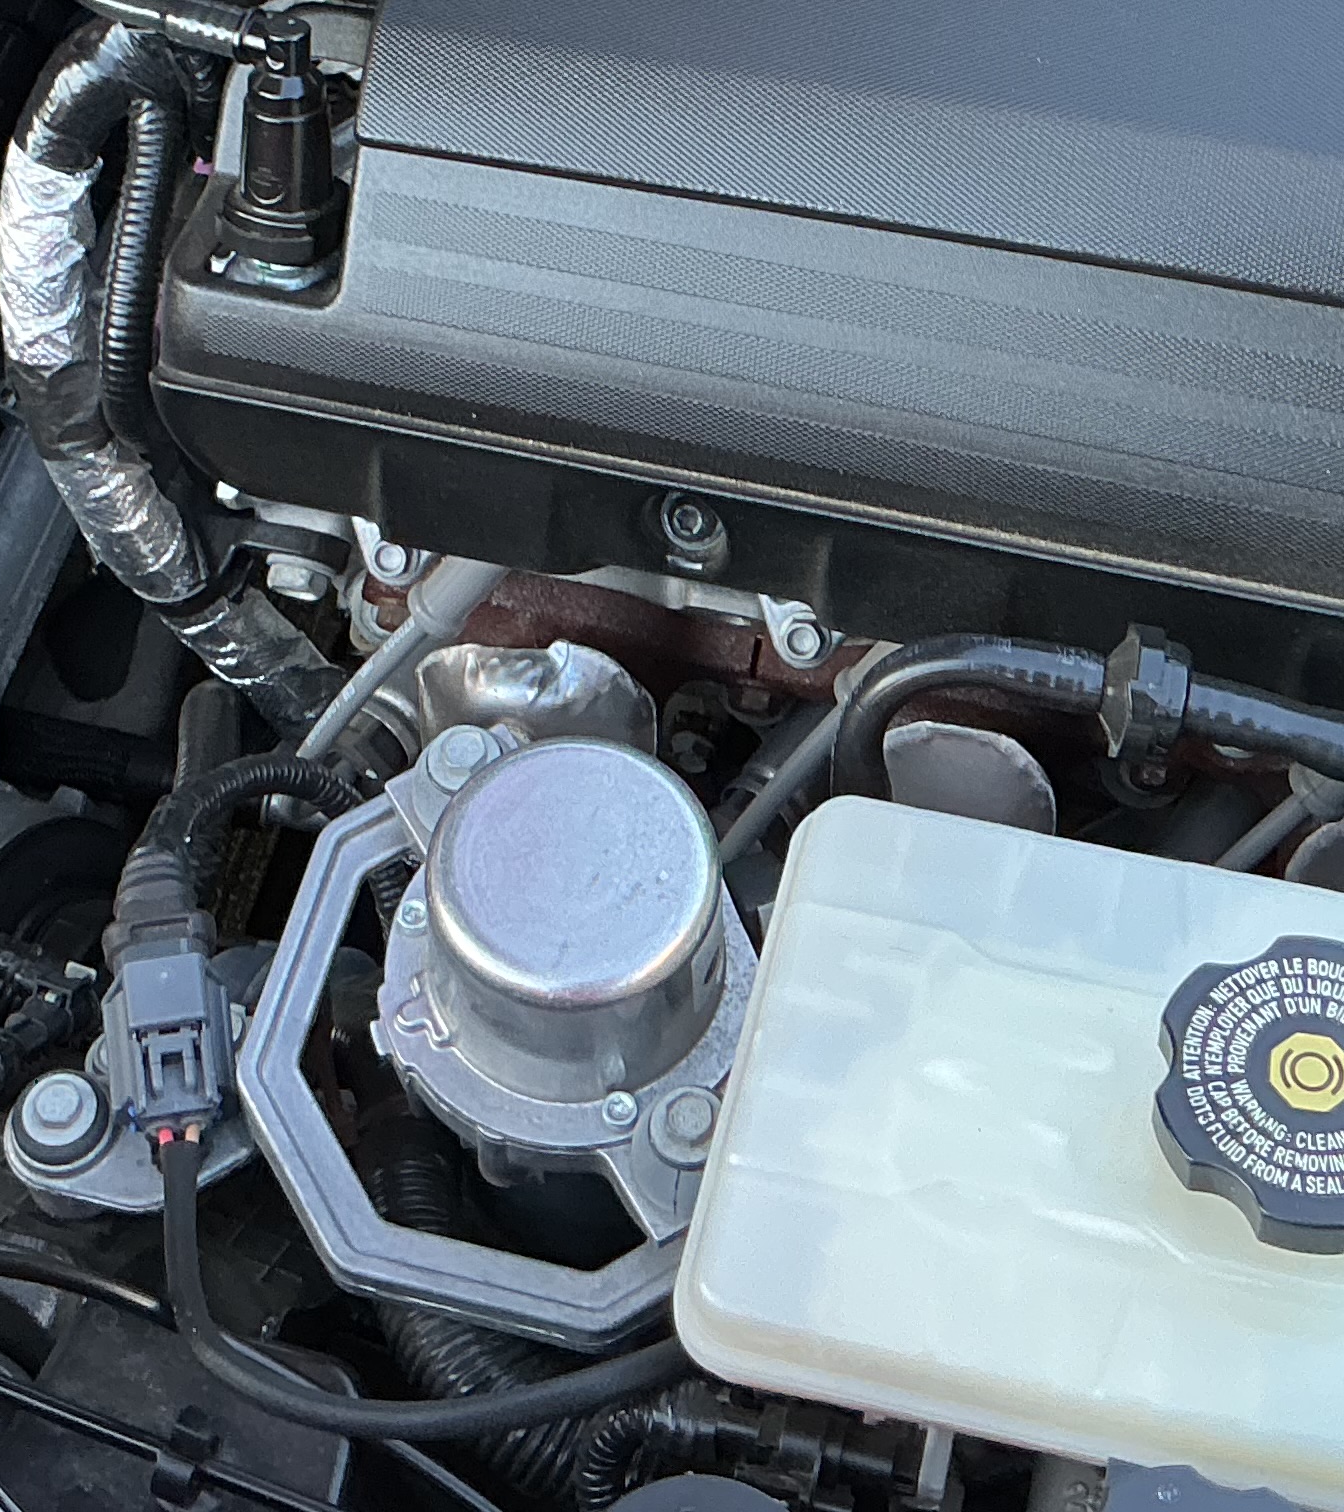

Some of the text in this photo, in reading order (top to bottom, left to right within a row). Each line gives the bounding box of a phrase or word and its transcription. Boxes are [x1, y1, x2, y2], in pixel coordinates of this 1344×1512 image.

[1183, 1004, 1217, 1080] ATTENTION:
[1209, 960, 1280, 1004] NETTOYER
[1283, 957, 1303, 975] LE
[1205, 996, 1251, 1075] N'EMPLOYER
[1246, 980, 1280, 1004] QUE
[1280, 977, 1303, 995] DU
[1227, 1000, 1282, 1074] PROVENANT
[1284, 997, 1321, 1015] D'UN
[1186, 1086, 1216, 1125] DOT3
[1206, 1122, 1247, 1162] FLUID
[1242, 1154, 1290, 1188] FROM
[1290, 1173, 1302, 1193] A
[1208, 1081, 1232, 1107] CAP
[1221, 1108, 1274, 1157] BEFORE
[1230, 1078, 1292, 1143] WARNING:
